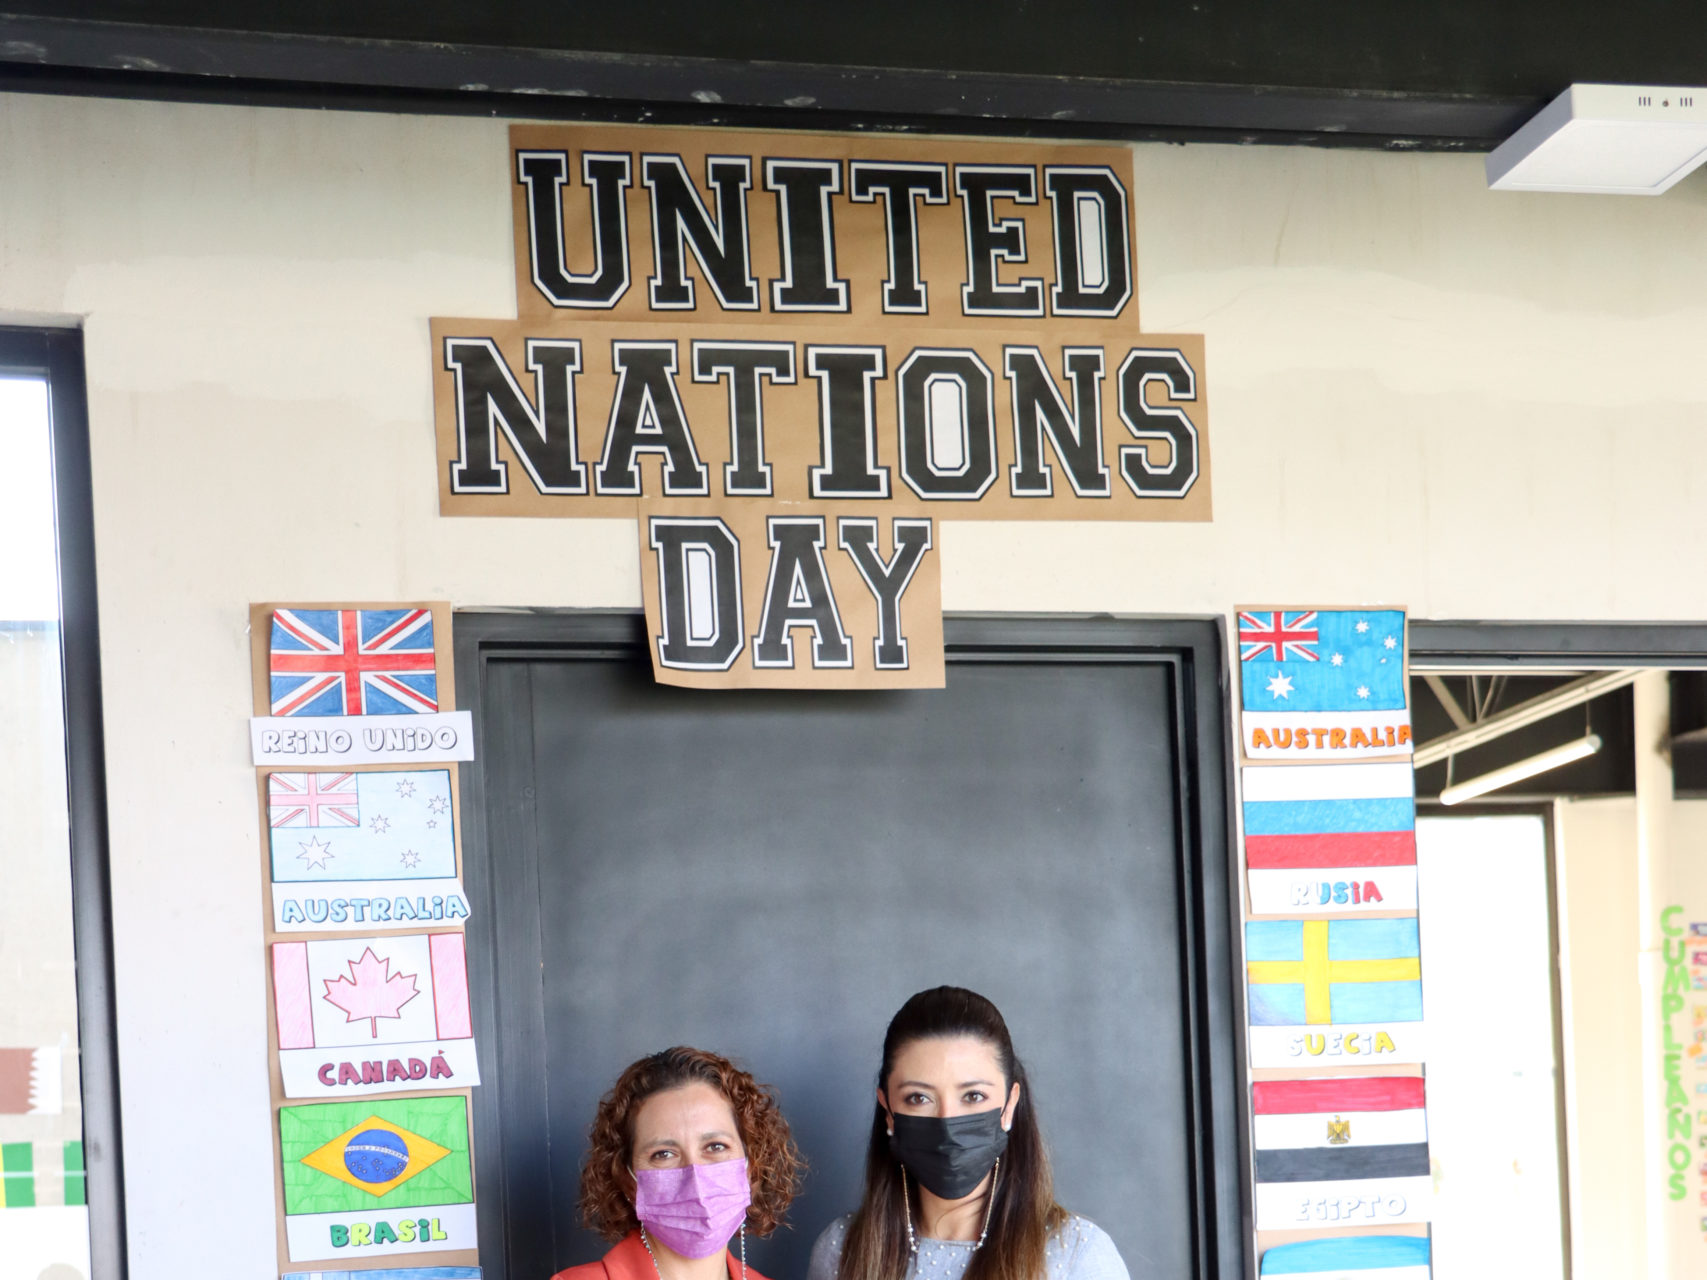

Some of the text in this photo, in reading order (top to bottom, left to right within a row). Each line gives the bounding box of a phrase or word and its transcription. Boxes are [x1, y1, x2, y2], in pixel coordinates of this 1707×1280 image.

[515, 148, 1133, 318] UNITED
[443, 336, 1199, 501] NATIONS
[648, 515, 934, 672] DAY
